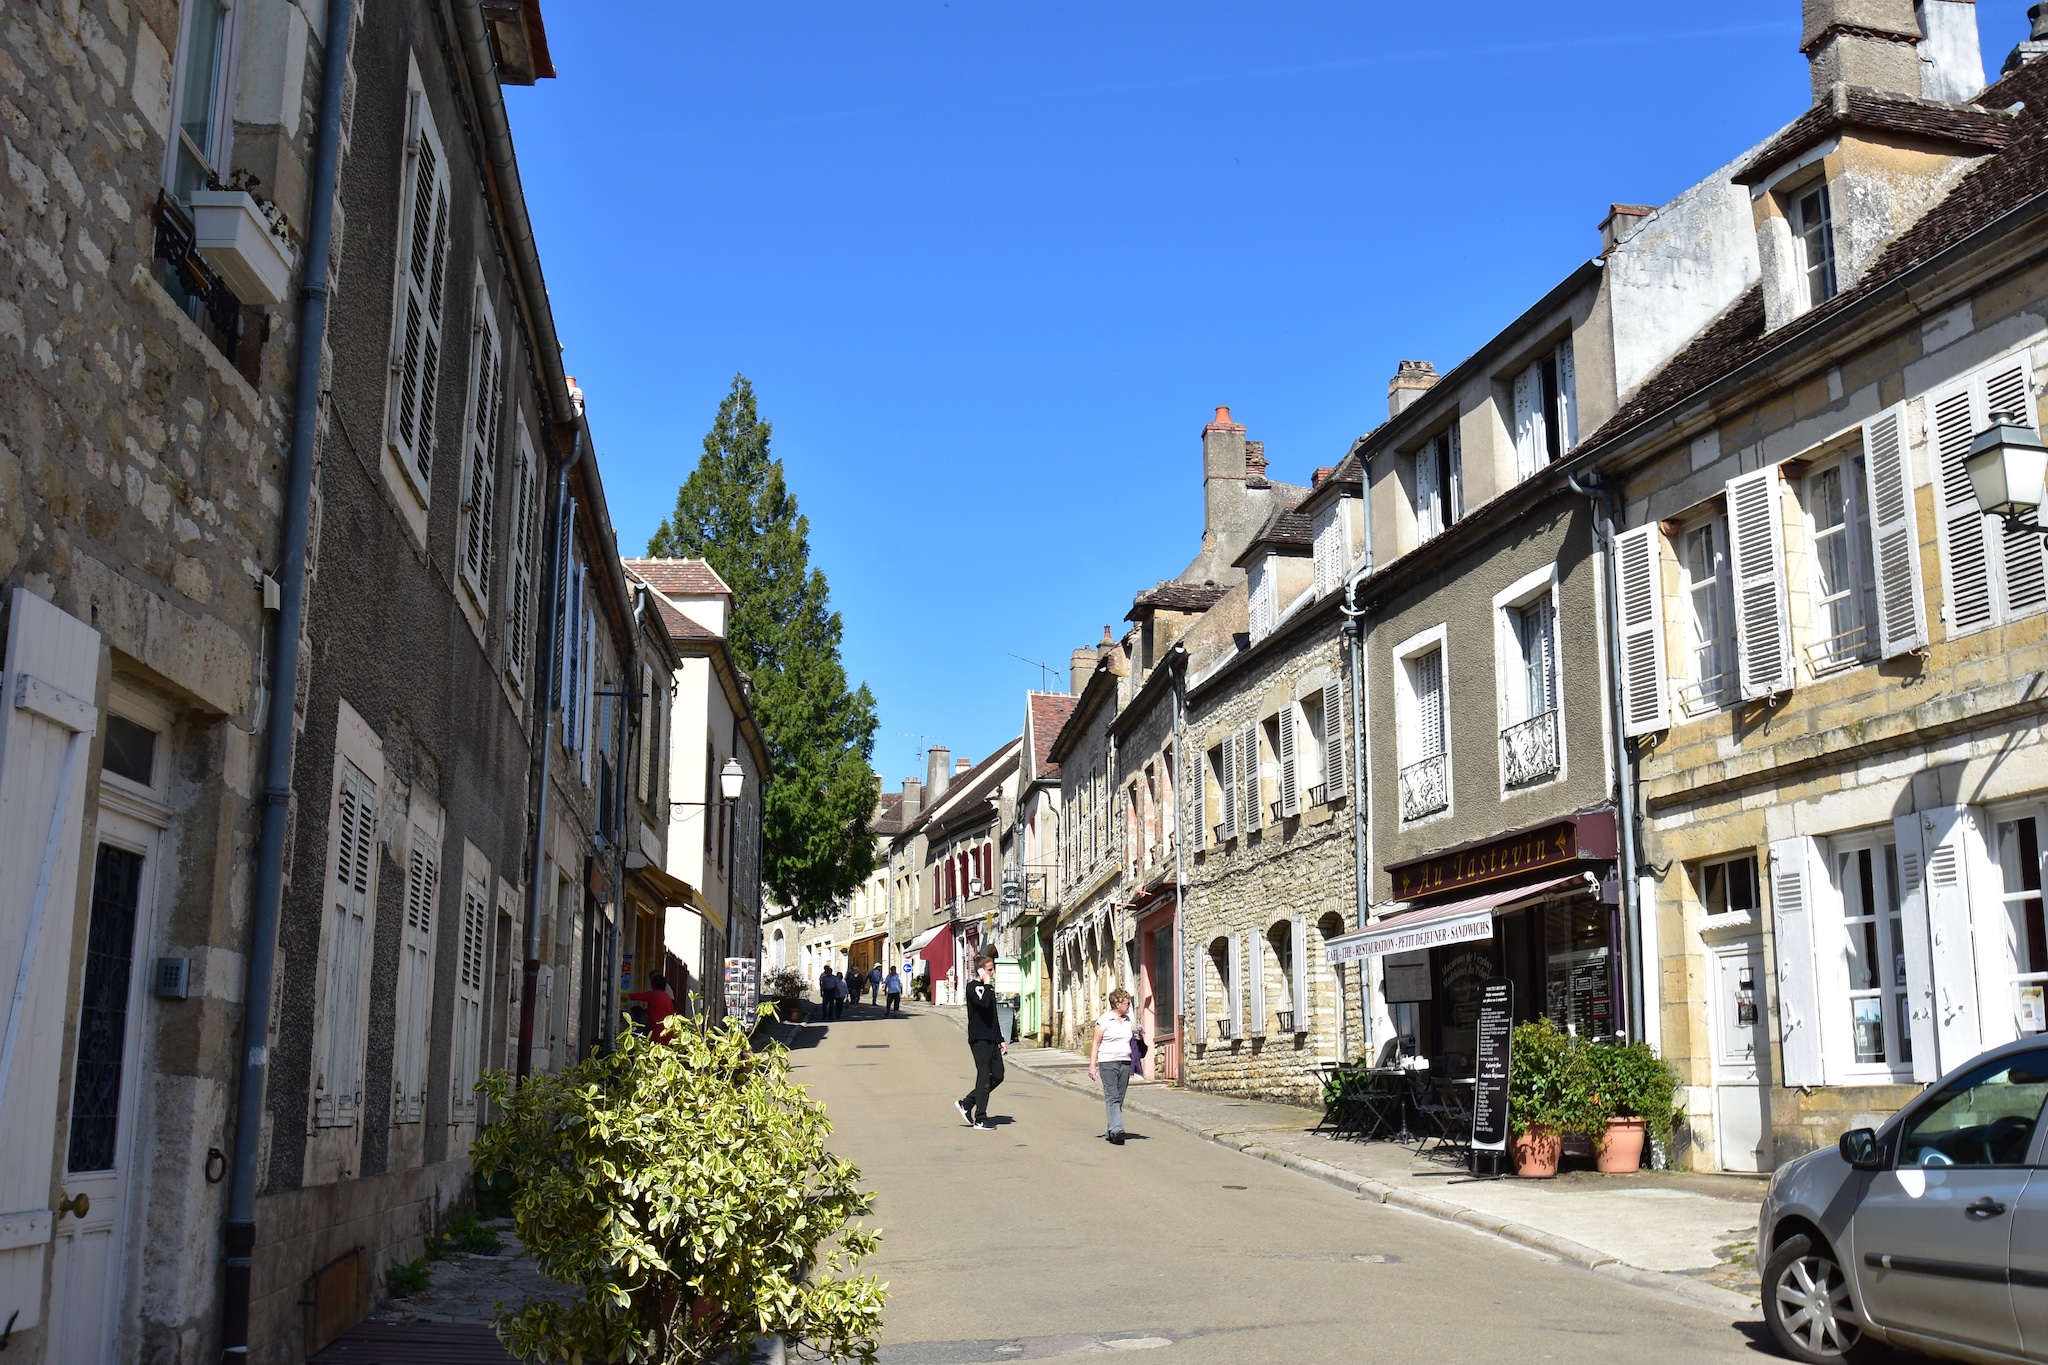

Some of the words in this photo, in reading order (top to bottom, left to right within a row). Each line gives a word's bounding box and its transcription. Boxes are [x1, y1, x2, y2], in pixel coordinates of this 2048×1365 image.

[1417, 863, 1443, 894] Au
[1453, 834, 1547, 882] Tastevin
[1326, 943, 1339, 962] CAFÉ
[1341, 942, 1352, 959] THÉ
[1355, 937, 1395, 956] RESTAURATION
[1398, 933, 1414, 948] PETIT
[1415, 928, 1447, 945] DÉJEUNER
[1450, 920, 1490, 939] SANDWICHS
